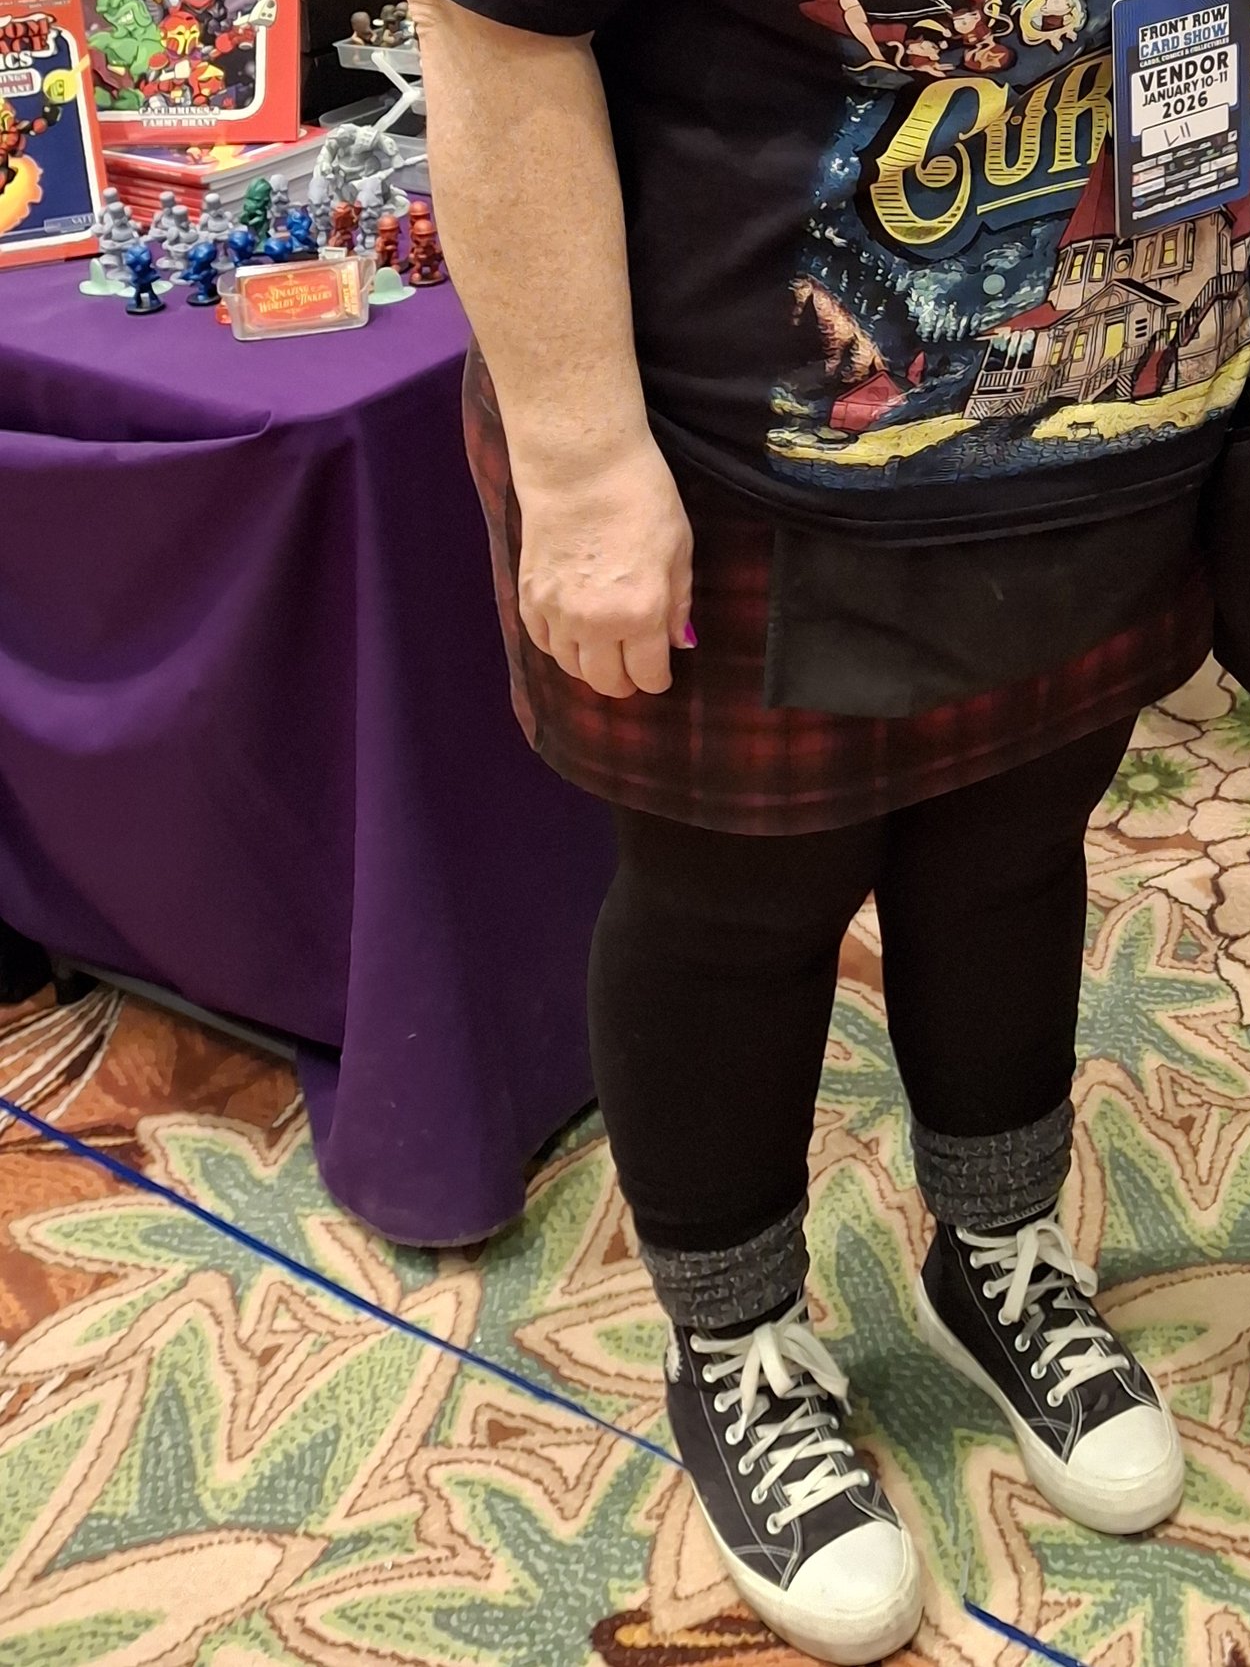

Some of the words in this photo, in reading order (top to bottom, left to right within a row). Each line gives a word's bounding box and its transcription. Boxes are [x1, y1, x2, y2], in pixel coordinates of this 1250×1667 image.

[1141, 17, 1188, 42] FRONT
[1193, 6, 1227, 28] ROW
[1141, 35, 1180, 58] CARD
[1184, 22, 1227, 46] SHOW
[1139, 51, 1229, 92] VENDOR
[1143, 79, 1199, 107] JANUARY
[1201, 71, 1228, 88] 10-11
[1163, 91, 1208, 119] 2026
